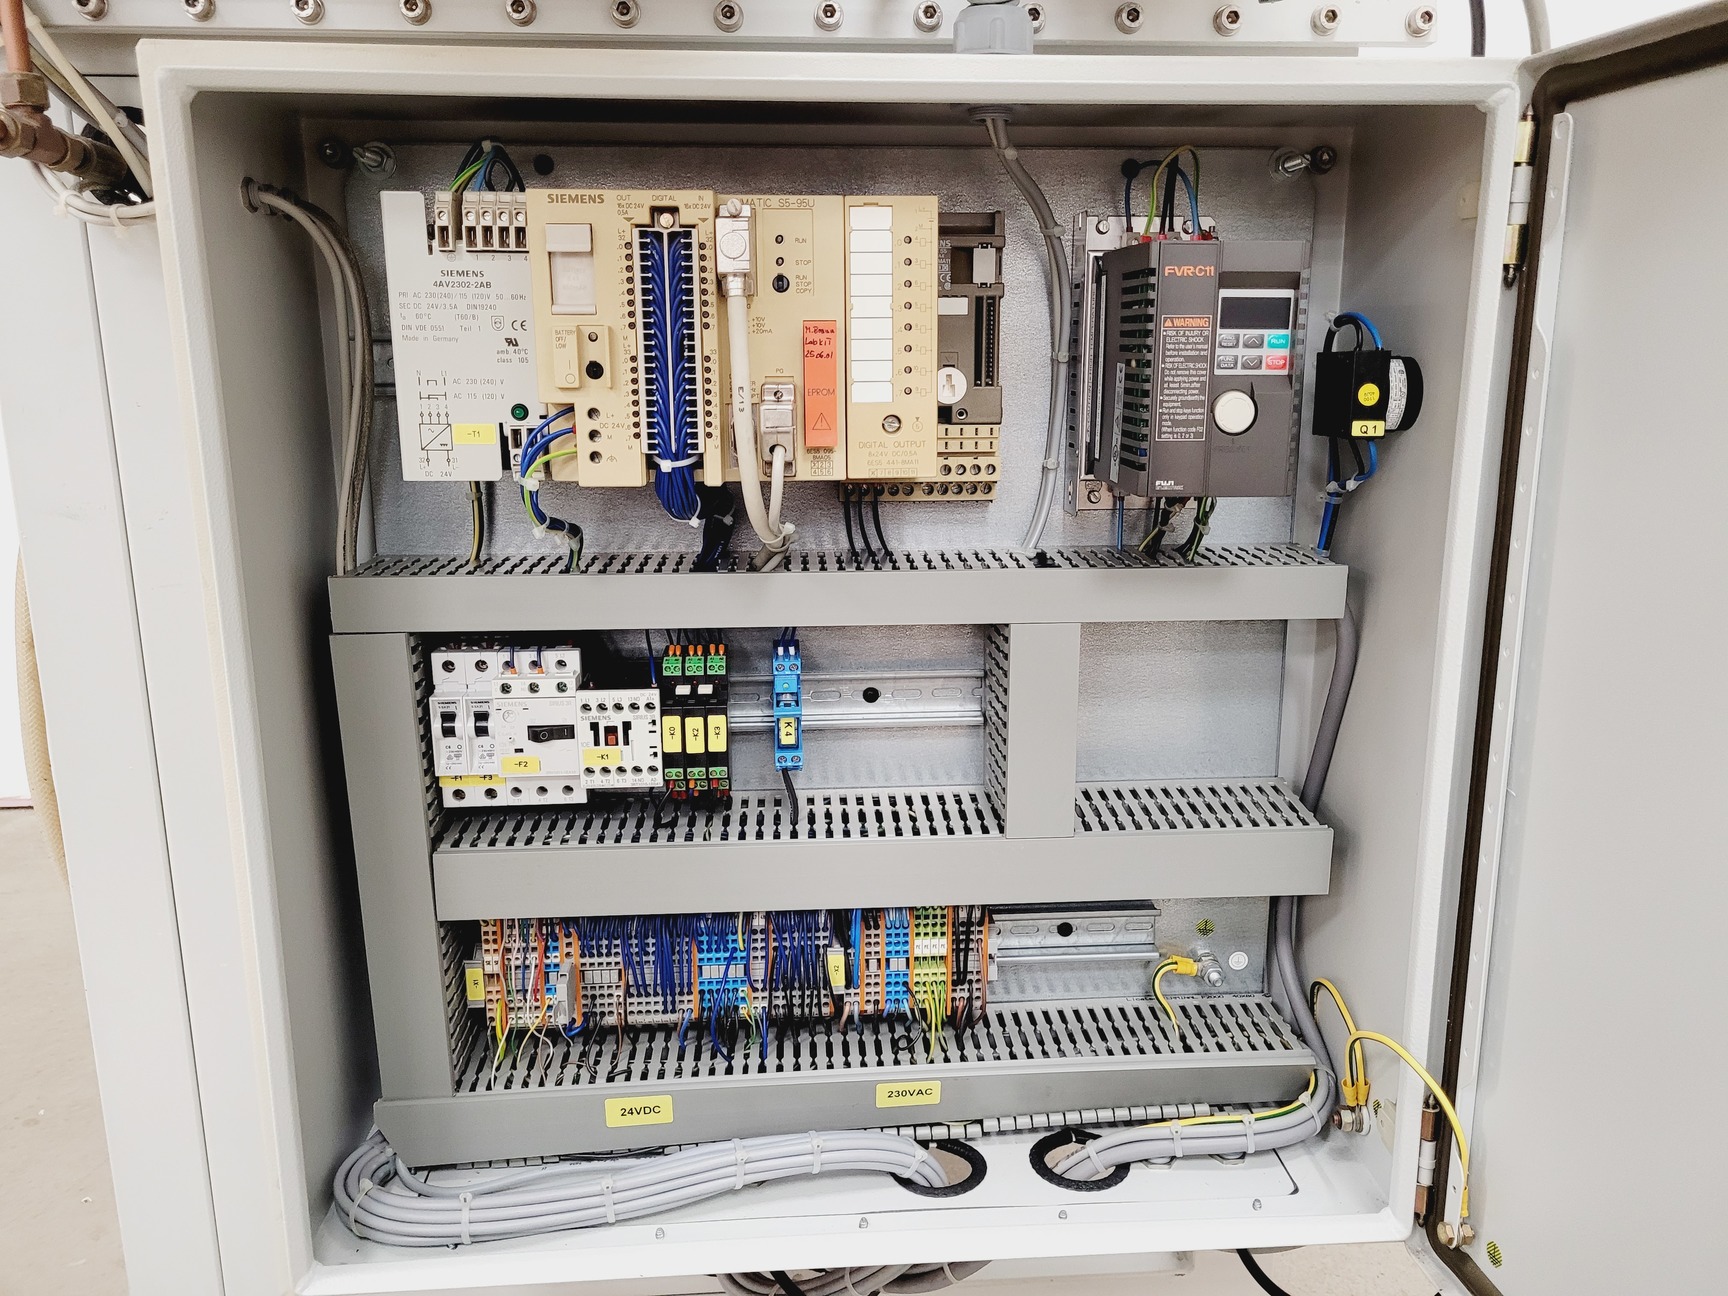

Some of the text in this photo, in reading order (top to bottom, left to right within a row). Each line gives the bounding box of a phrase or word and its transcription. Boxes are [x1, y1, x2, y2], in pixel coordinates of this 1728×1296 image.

[547, 193, 605, 204] SIEMENS
[651, 194, 677, 202] DIGITAL
[740, 198, 815, 208] MATIC S5-95U
[440, 269, 485, 278] SIEMENS
[432, 281, 492, 289] 4AV2302-2AB
[1172, 318, 1209, 327] WARNING
[432, 335, 459, 343] Germany
[807, 388, 835, 396] EPROM
[1359, 424, 1377, 434] Q 1
[893, 440, 926, 448] OUTPUT
[887, 1088, 934, 1098] 230VAC
[620, 1105, 662, 1117] 24VDC
